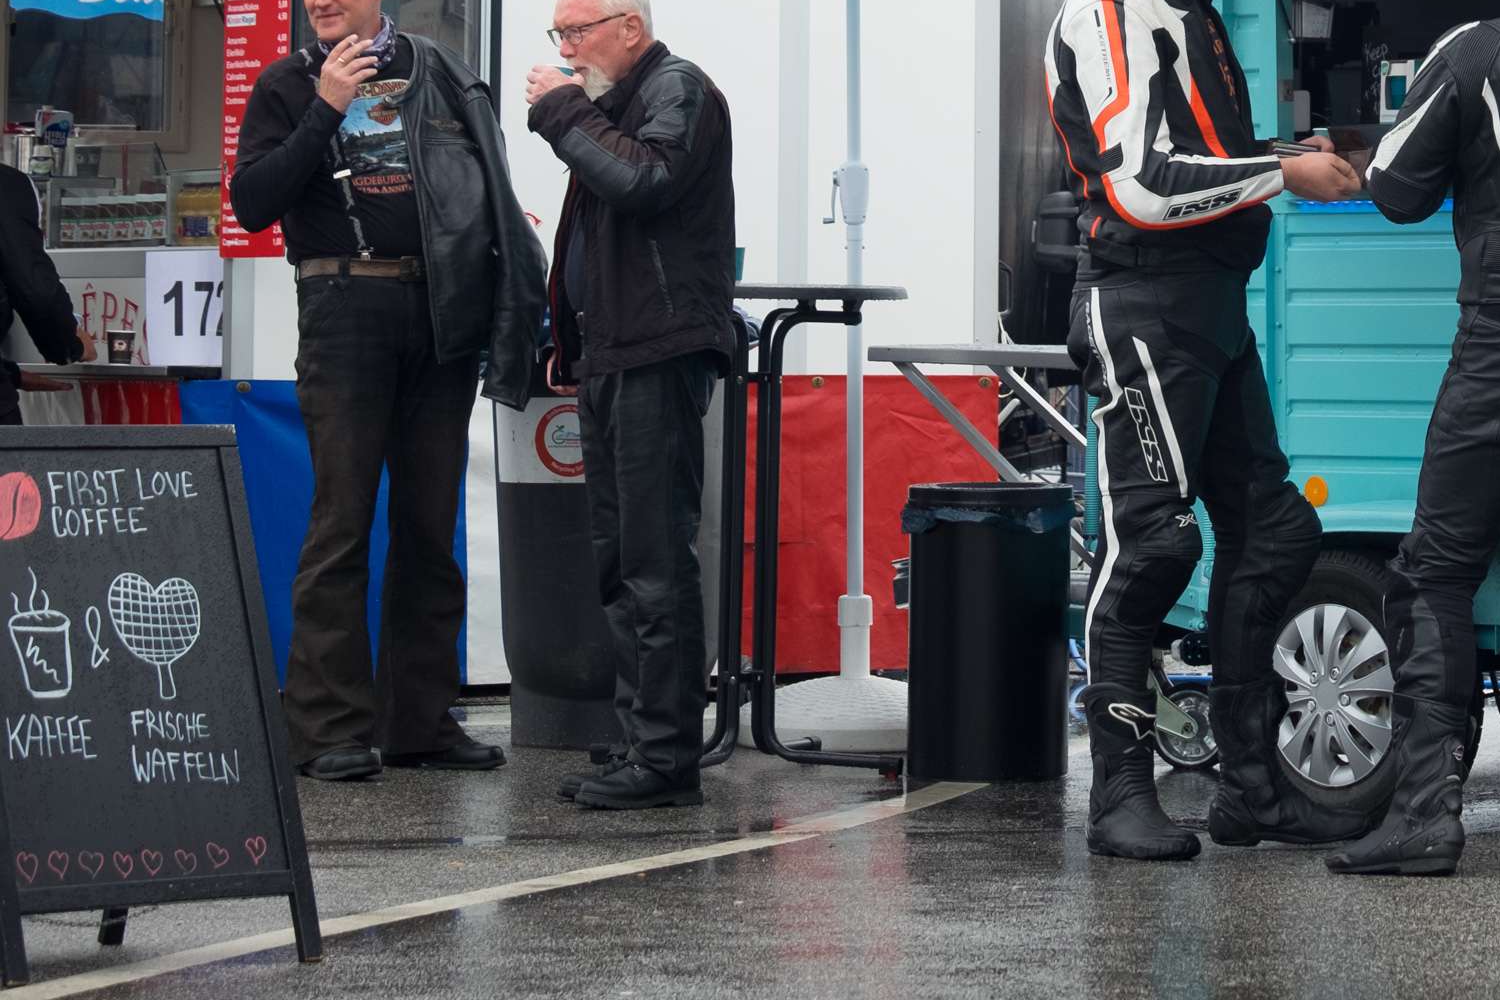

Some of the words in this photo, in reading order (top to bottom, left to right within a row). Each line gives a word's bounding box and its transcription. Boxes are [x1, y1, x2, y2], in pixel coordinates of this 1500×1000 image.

[47, 468, 126, 505] FIRST
[135, 467, 199, 500] LOVE
[50, 506, 148, 538] COFFEE
[7, 713, 98, 760] KAFFEE
[131, 707, 210, 744] FRISCHE
[131, 744, 240, 785] WAFFELN
